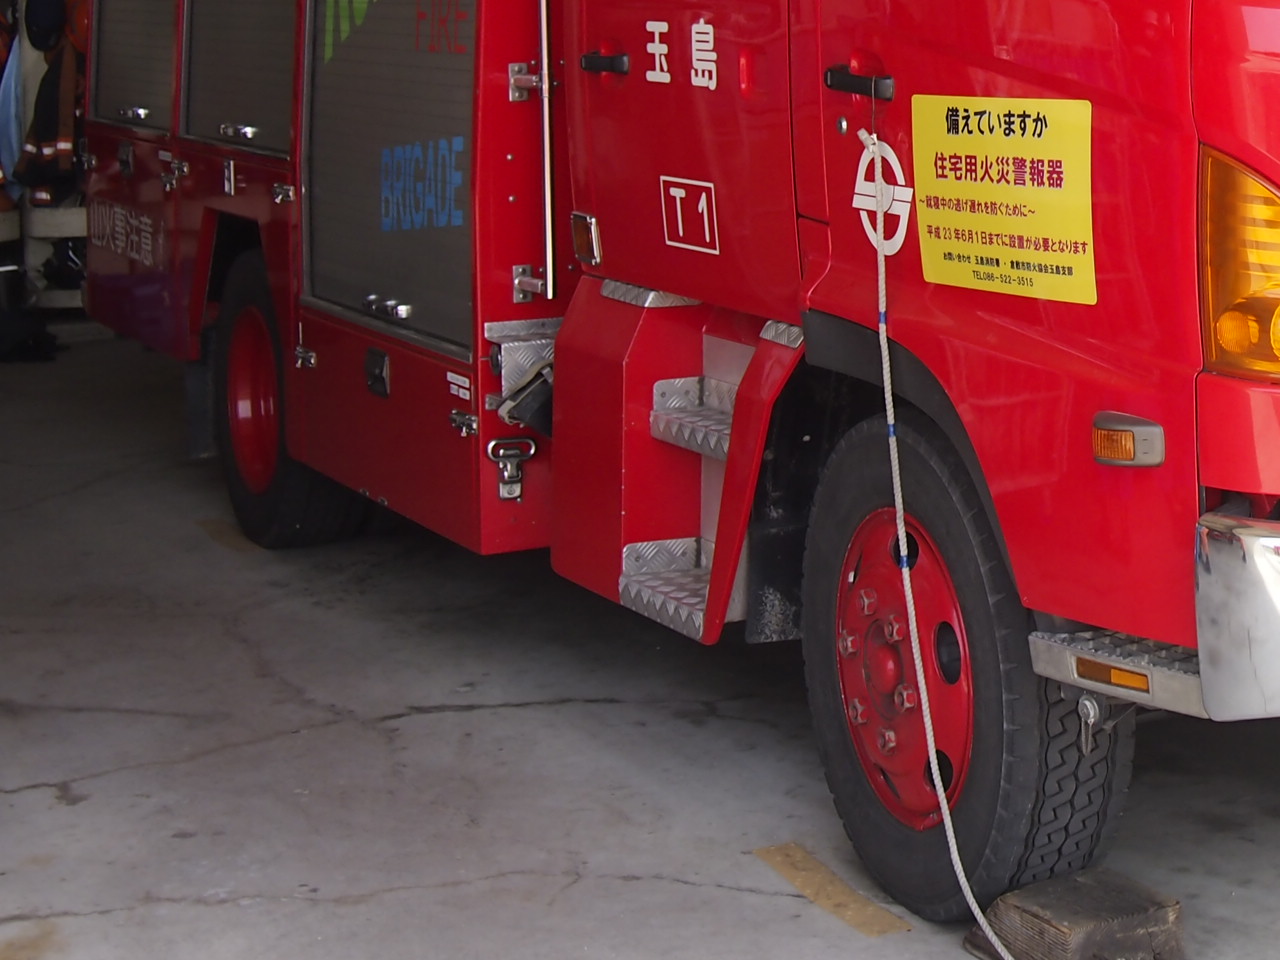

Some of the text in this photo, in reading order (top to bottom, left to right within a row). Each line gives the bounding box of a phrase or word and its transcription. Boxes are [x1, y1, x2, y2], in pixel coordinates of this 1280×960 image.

[645, 17, 717, 91] 玉島
[945, 106, 1048, 138] 備えていますか
[380, 137, 464, 231] BRIGADE
[933, 152, 1064, 189] 住宅用火災警報器
